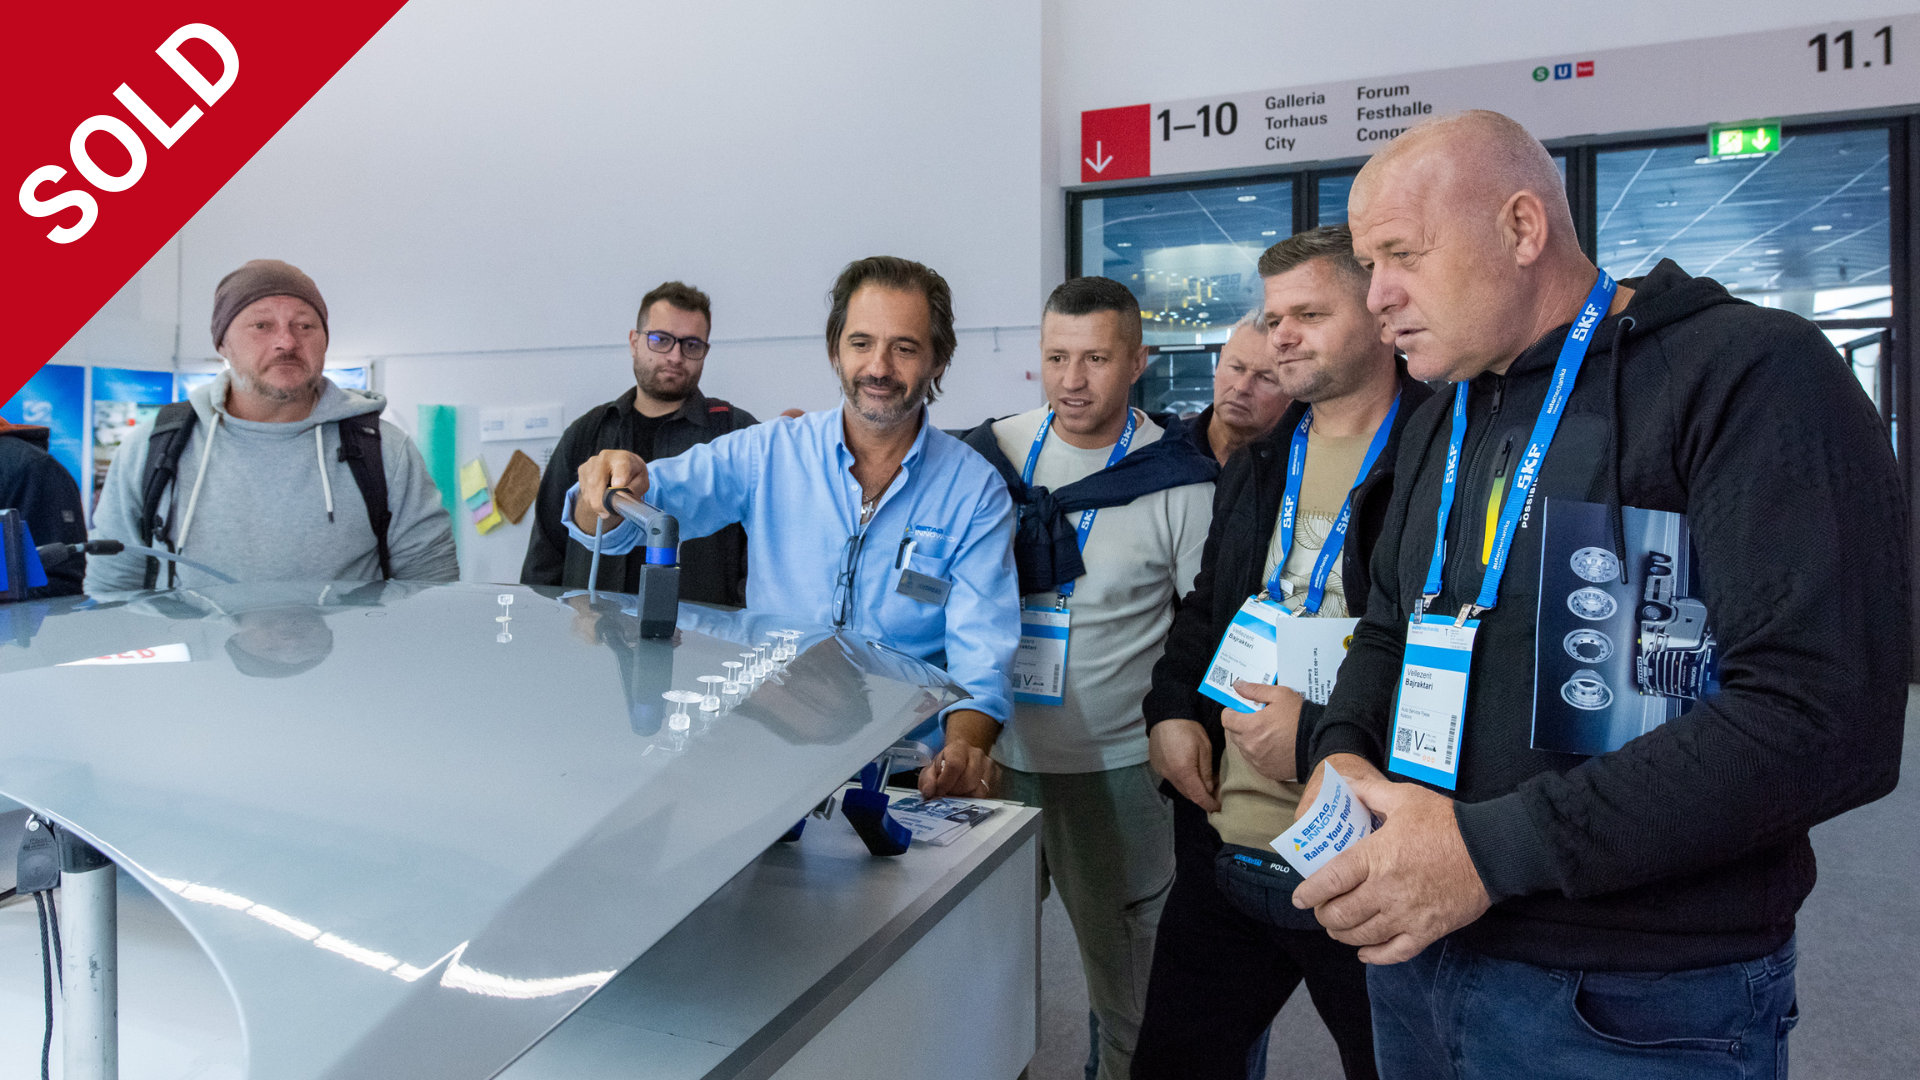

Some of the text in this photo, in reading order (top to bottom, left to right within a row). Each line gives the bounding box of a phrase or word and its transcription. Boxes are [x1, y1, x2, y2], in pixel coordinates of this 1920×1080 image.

[1807, 25, 1892, 72] 11.1
[1264, 91, 1326, 110] Galleria
[1356, 84, 1410, 100] Forum
[1264, 114, 1328, 130] Torhaus
[1356, 101, 1433, 121] Festhalle
[1264, 136, 1296, 151] City
[1571, 303, 1599, 342] SKF
[1120, 420, 1134, 447] SKF
[1445, 443, 1459, 484] SKF
[1517, 443, 1541, 490] SKF
[1283, 495, 1296, 529] SKF
[1492, 520, 1511, 570] automechanika
[1023, 674, 1034, 687] V
[1405, 678, 1433, 691] Bajraktari
[1414, 730, 1426, 751] V
[1301, 803, 1331, 837] BETAG
[1306, 784, 1342, 842] INNOVATION
[1303, 793, 1352, 862] Raise Your Repair
[1333, 822, 1356, 852] Game!
[1270, 862, 1290, 874] POLO
